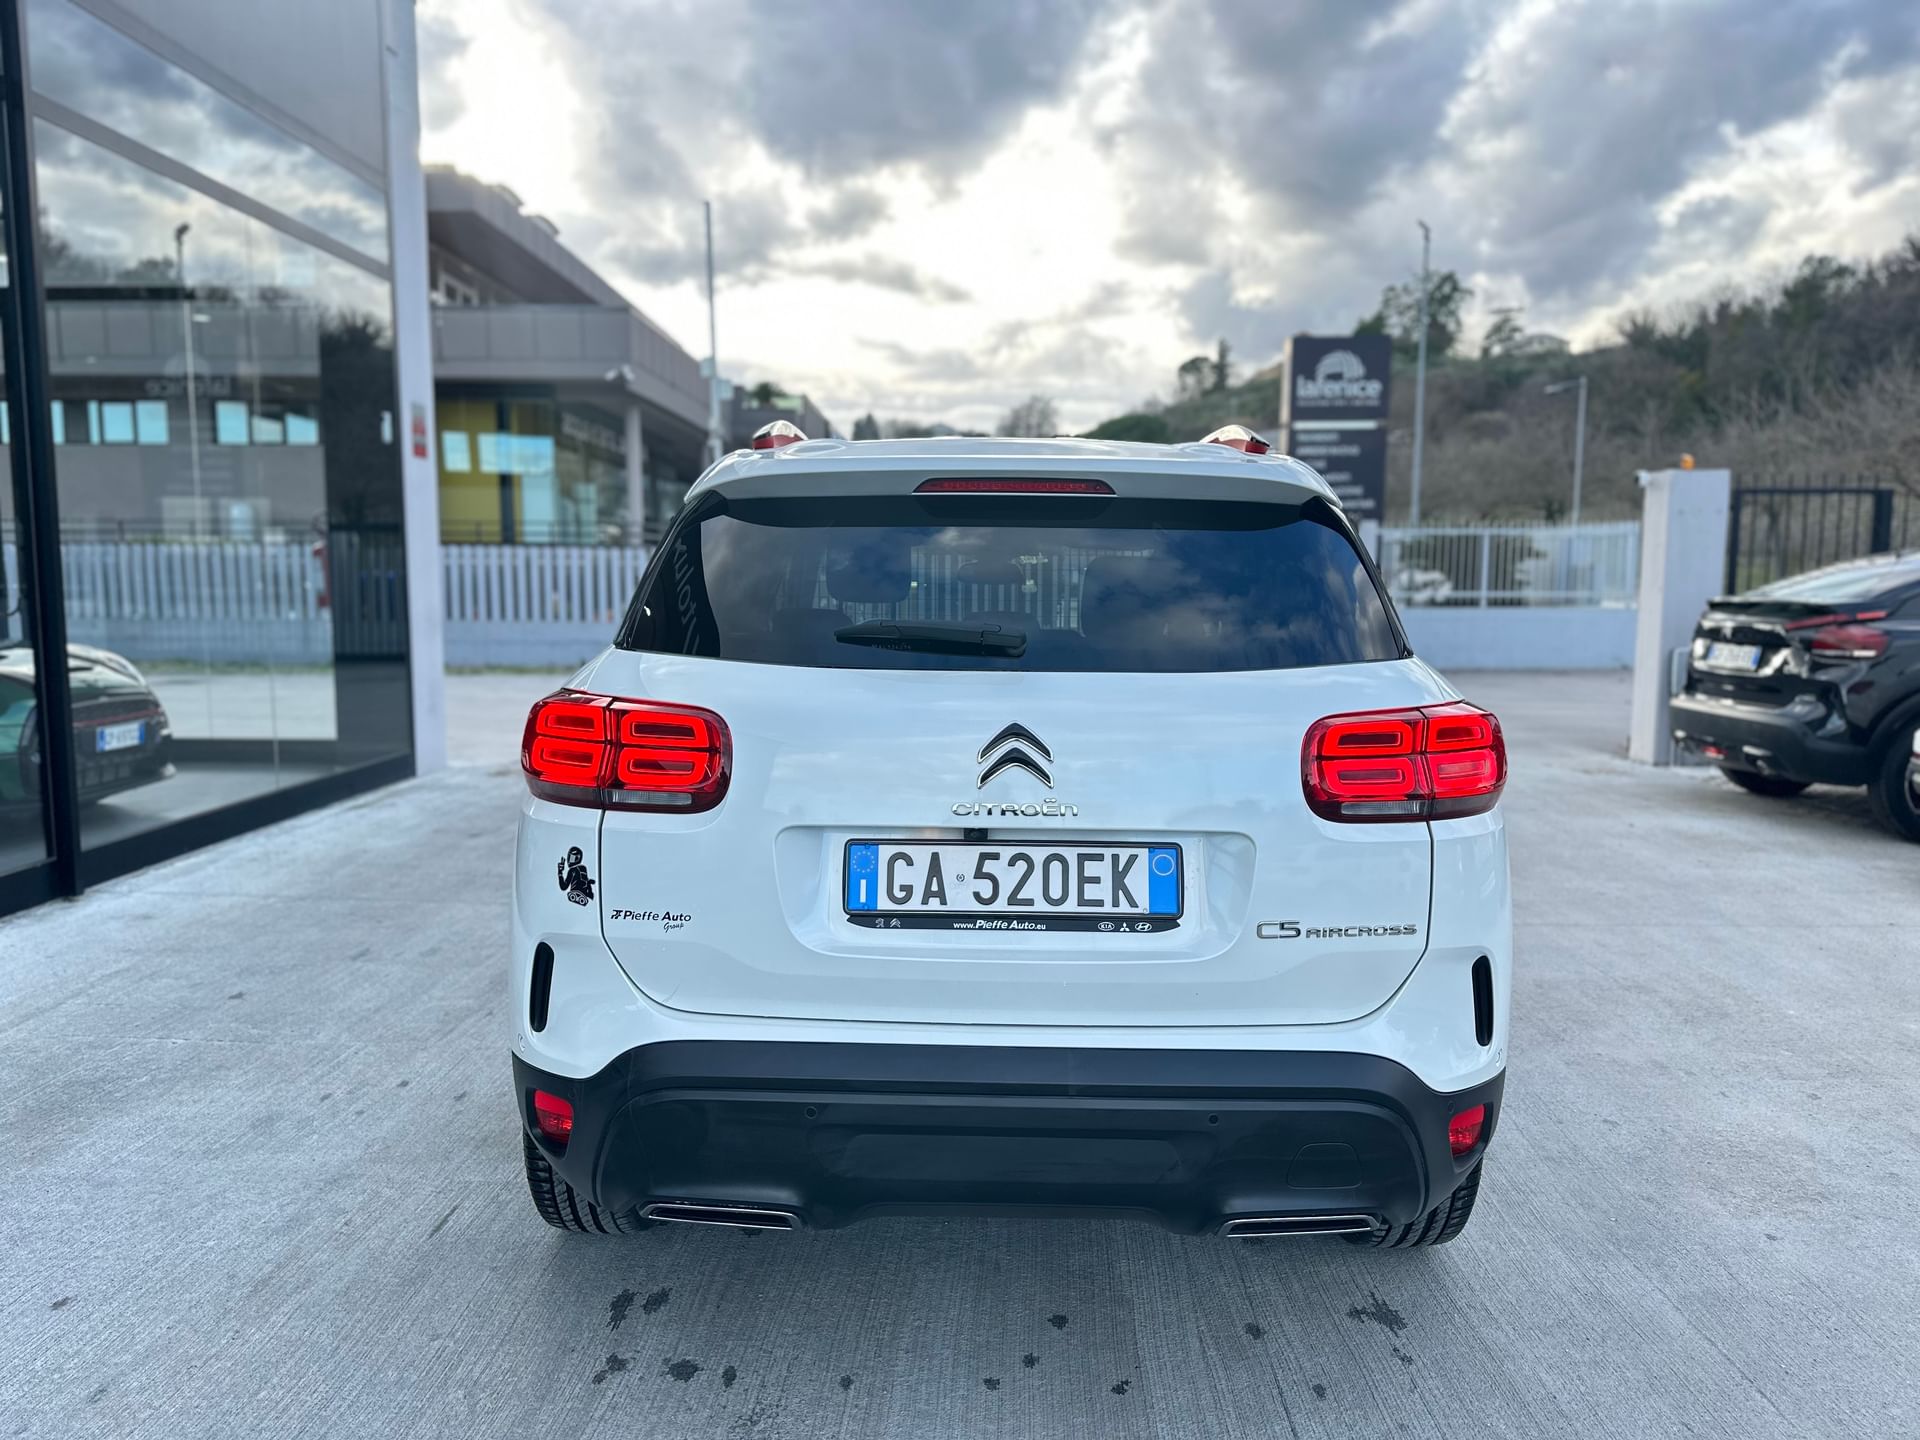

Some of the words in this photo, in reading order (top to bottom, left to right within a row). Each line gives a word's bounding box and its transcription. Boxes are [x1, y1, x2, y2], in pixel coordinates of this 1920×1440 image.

[886, 851, 948, 905] GA
[972, 852, 1139, 908] 520EK
[623, 910, 660, 921] Pieffe
[661, 911, 692, 922] Auto
[1256, 920, 1301, 939] C5
[1305, 924, 1417, 939] AIRCROSS
